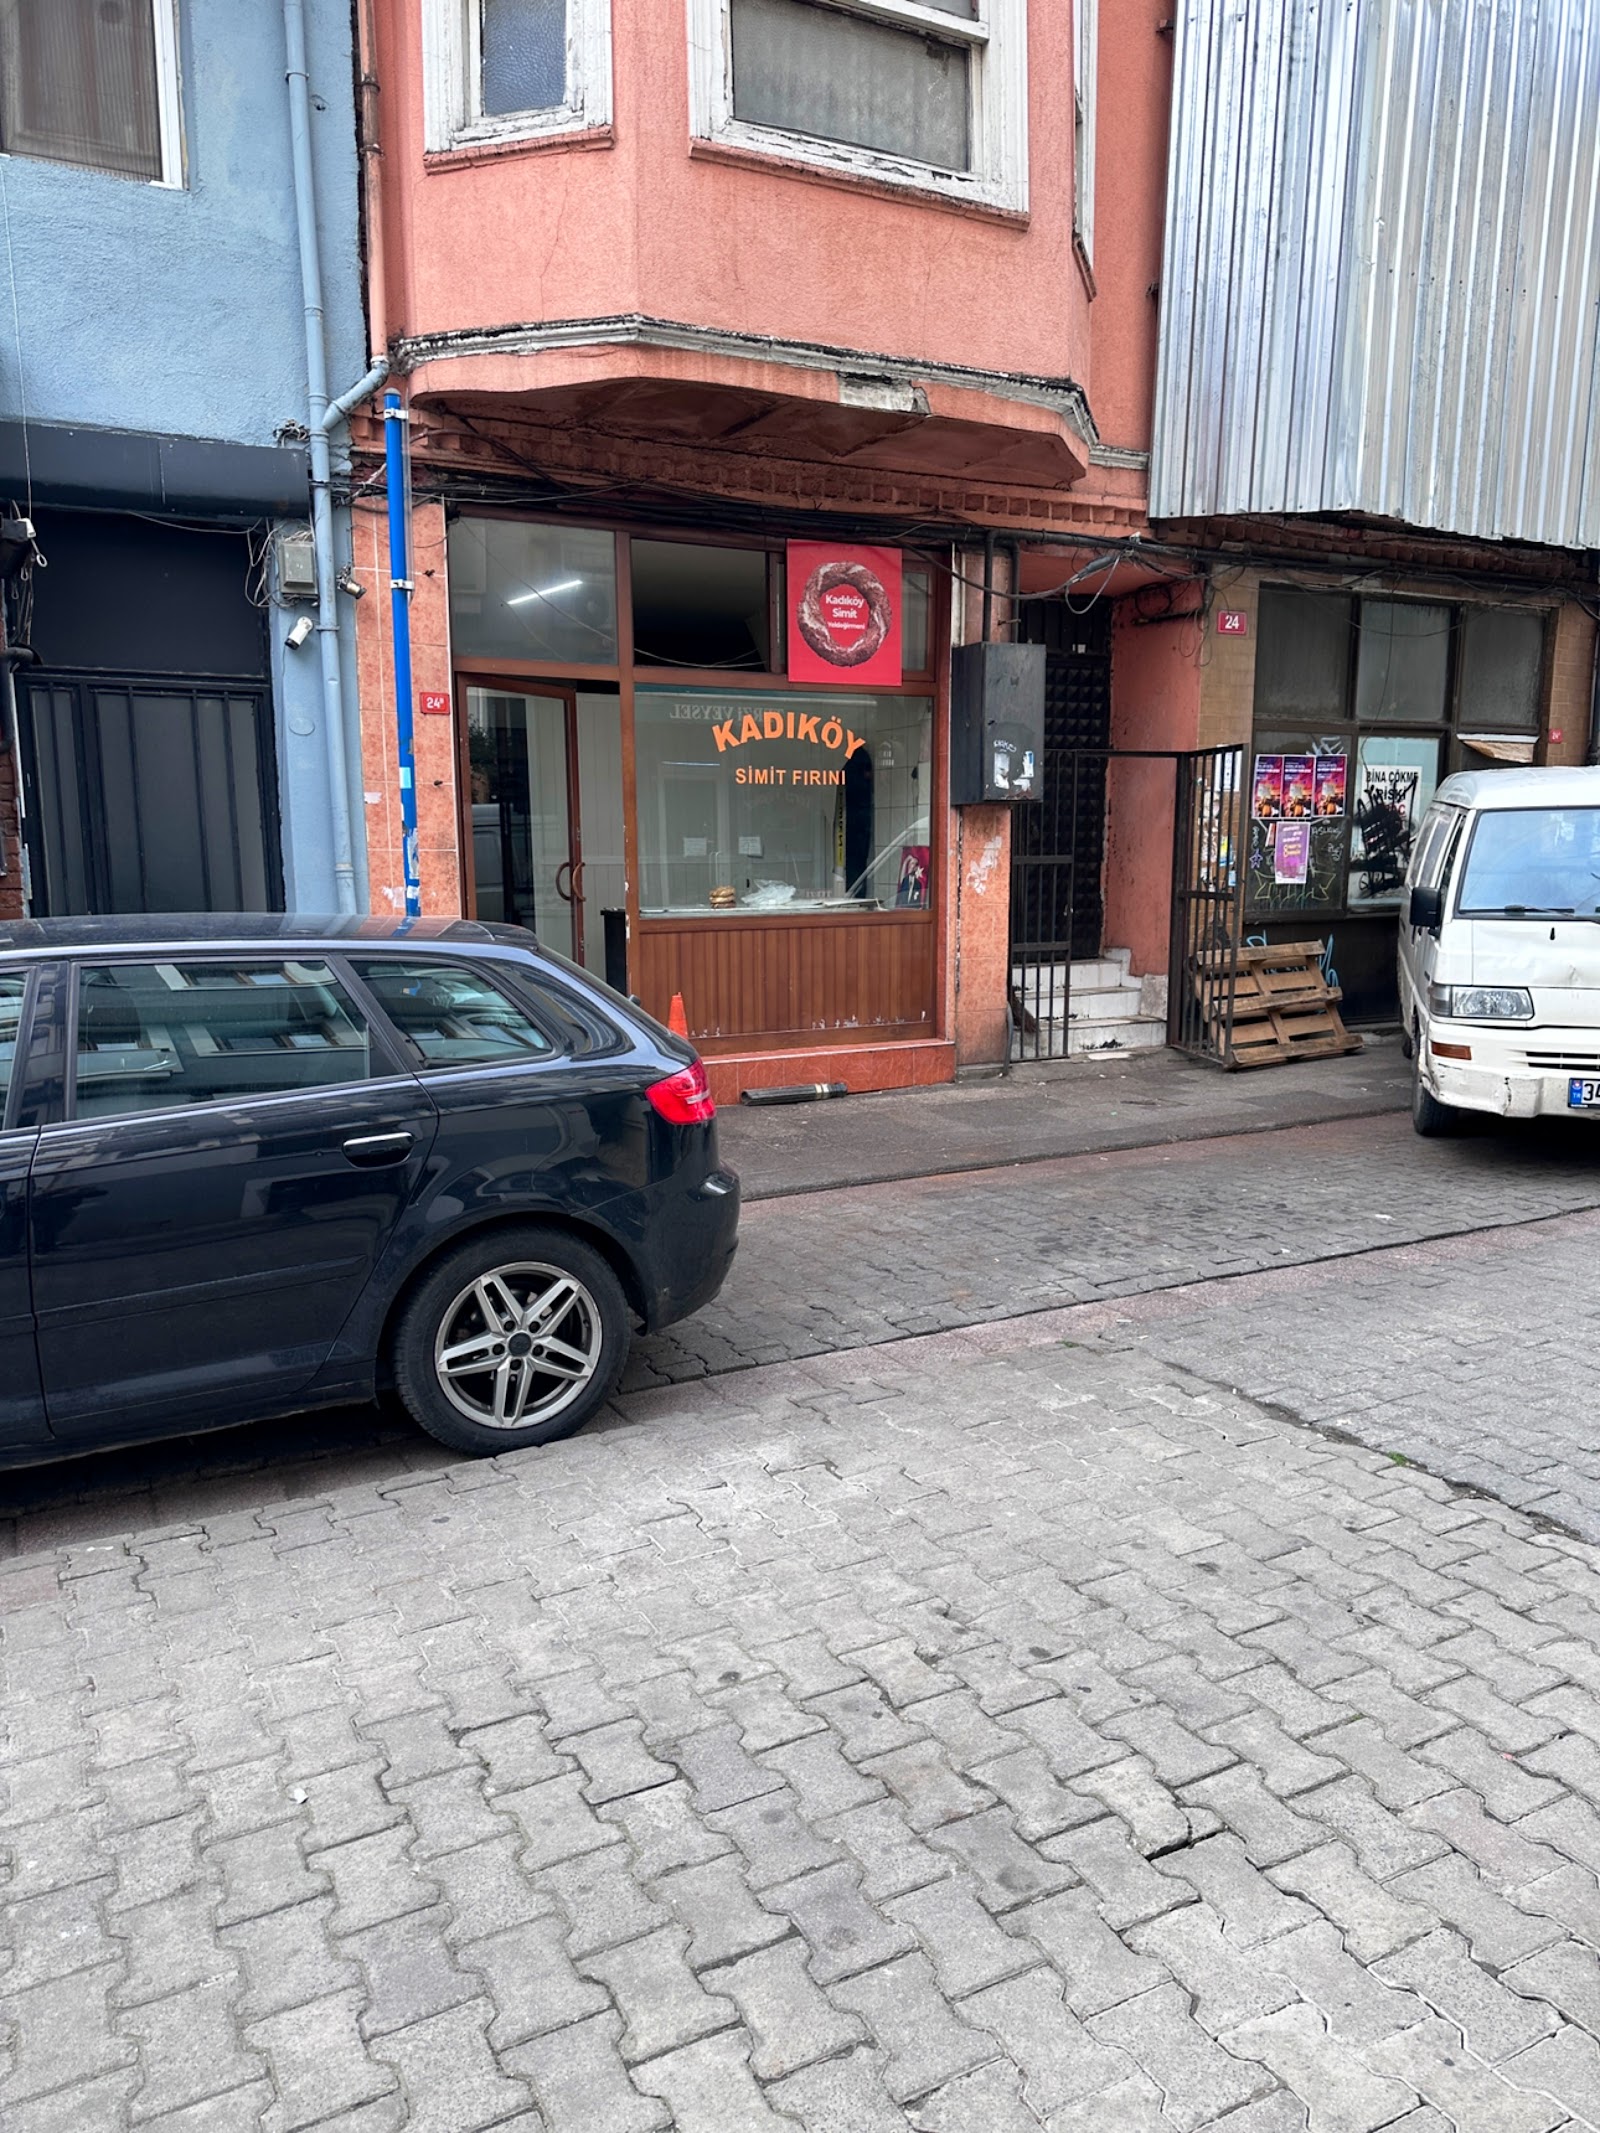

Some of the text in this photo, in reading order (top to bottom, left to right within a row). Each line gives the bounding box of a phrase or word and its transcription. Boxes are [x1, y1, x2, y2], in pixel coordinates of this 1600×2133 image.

[825, 594, 864, 608] Kadıköy
[832, 607, 858, 619] Simit
[1225, 614, 1240, 630] 24
[711, 711, 866, 760] KADIKÖY
[735, 765, 846, 786] SİMİT FIRINI
[1366, 768, 1386, 783] BİNA
